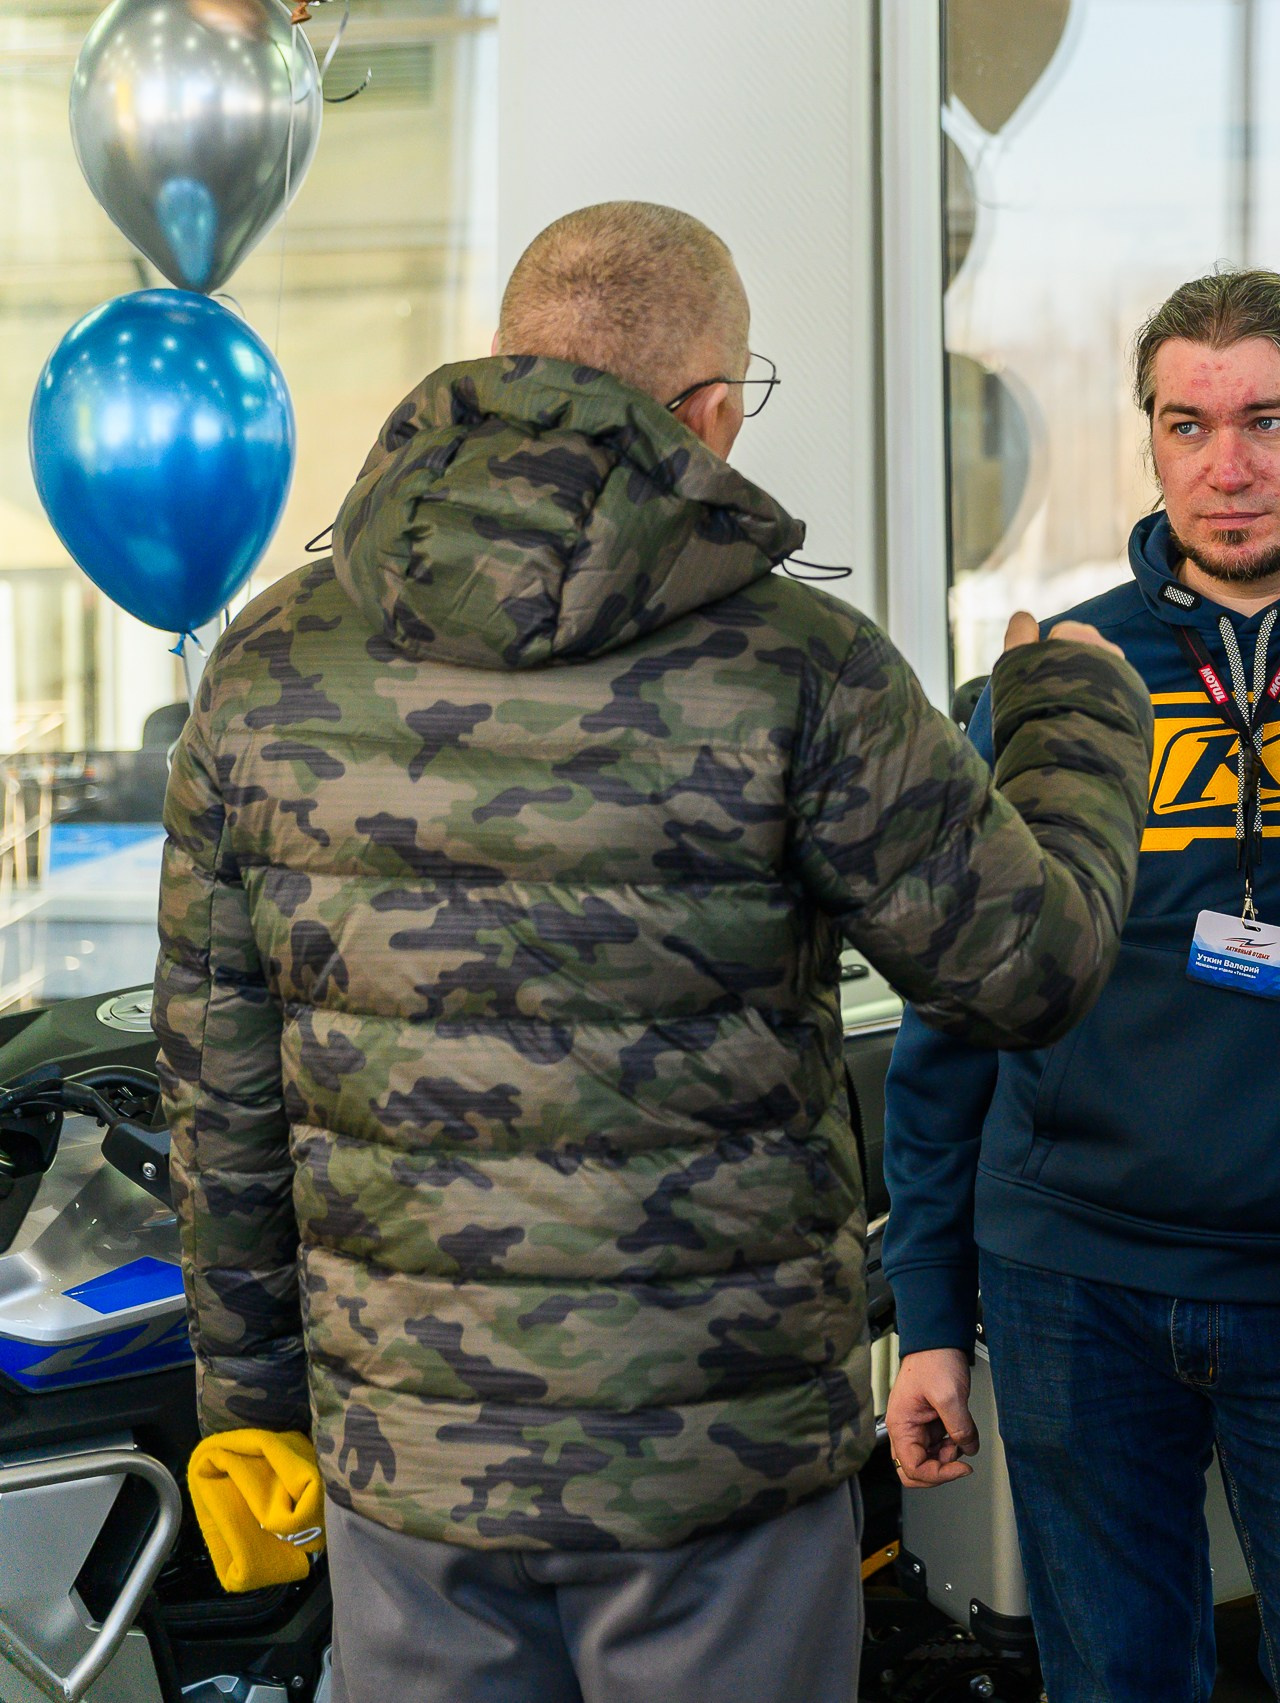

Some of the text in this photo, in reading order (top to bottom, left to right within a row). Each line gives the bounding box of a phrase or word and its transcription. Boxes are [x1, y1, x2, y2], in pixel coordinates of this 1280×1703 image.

[1200, 667, 1225, 703] MOTUL
[1196, 953, 1260, 974] Уткин Валерий
